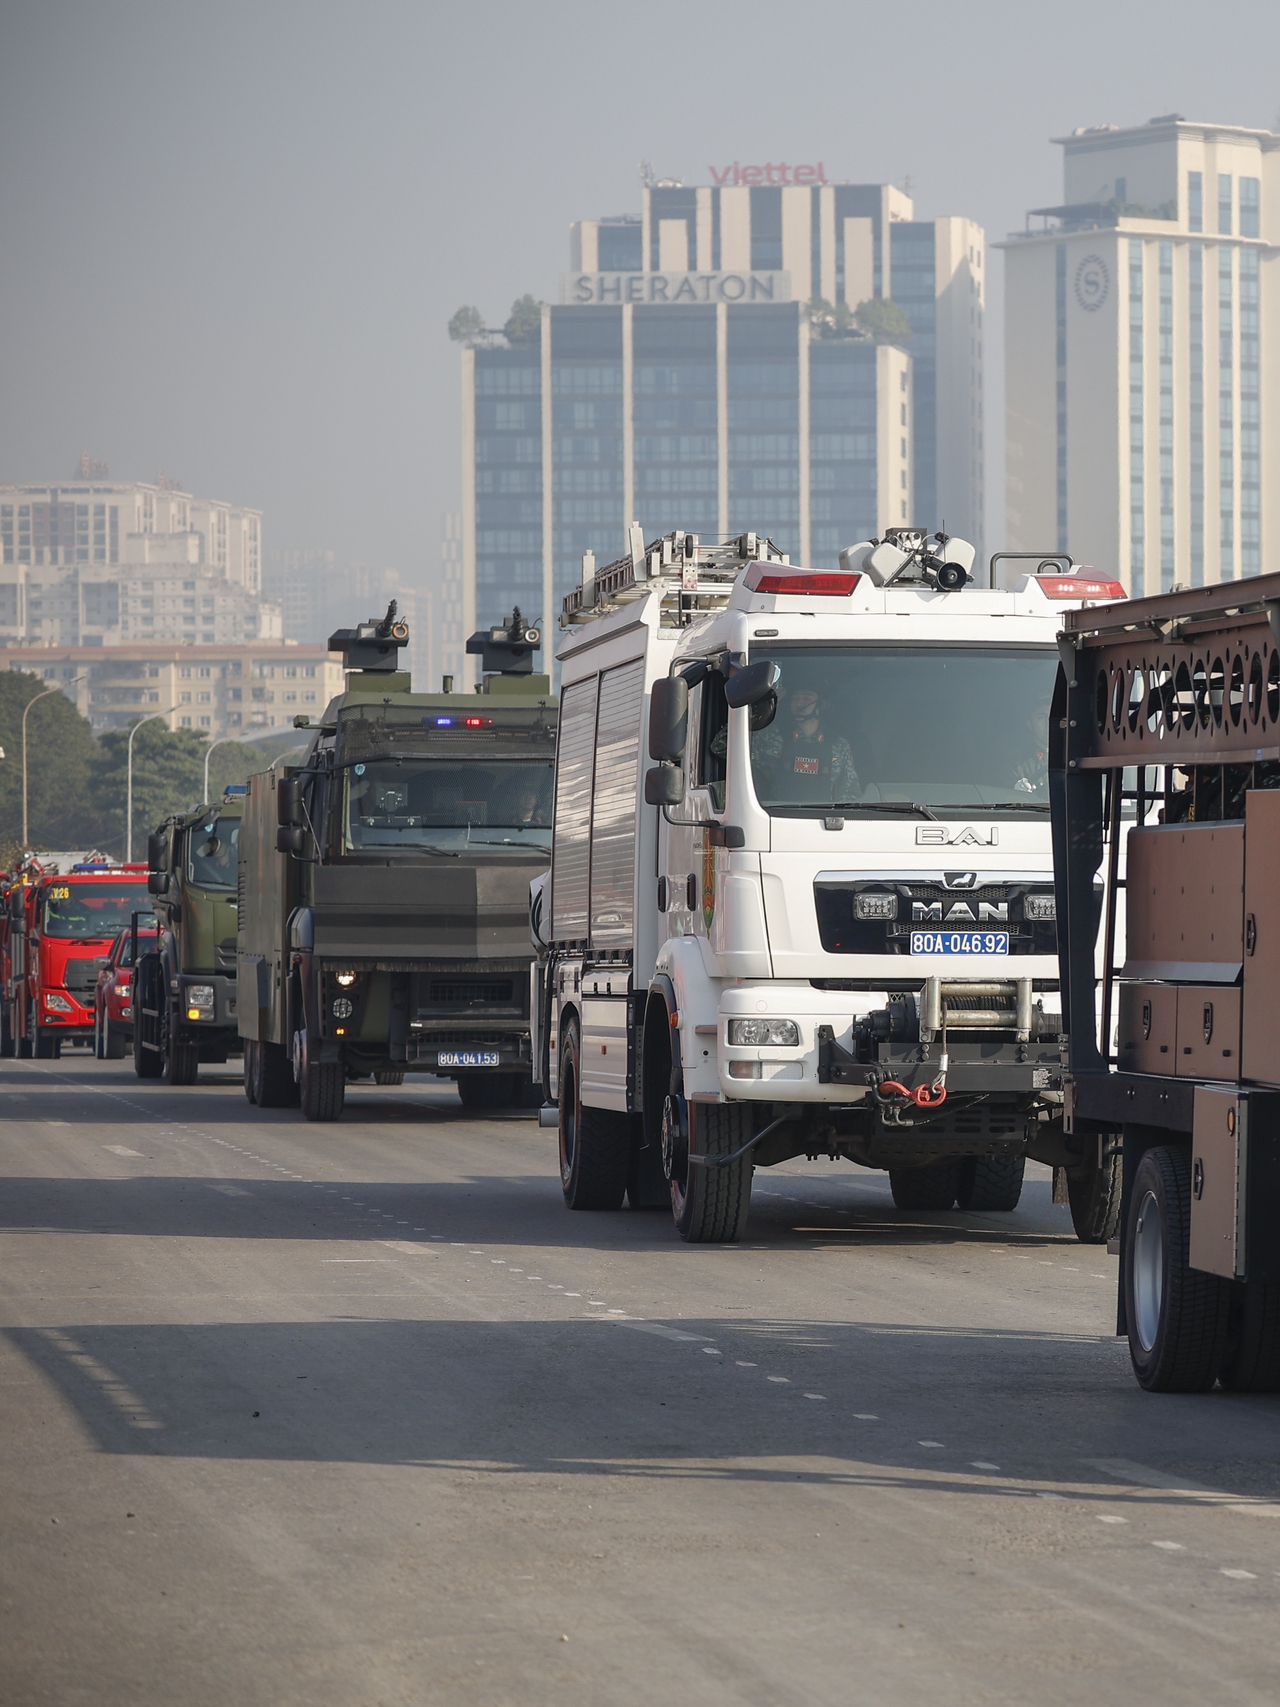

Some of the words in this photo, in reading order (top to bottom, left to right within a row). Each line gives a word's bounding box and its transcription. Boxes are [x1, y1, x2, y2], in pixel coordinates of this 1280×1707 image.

[708, 161, 829, 185] viettel
[575, 274, 775, 301] SHERATON
[915, 825, 999, 846] BAI
[911, 901, 1009, 922] MAN
[913, 934, 1006, 953] 80A-046.92
[440, 1052, 498, 1065] 80A-041.53
